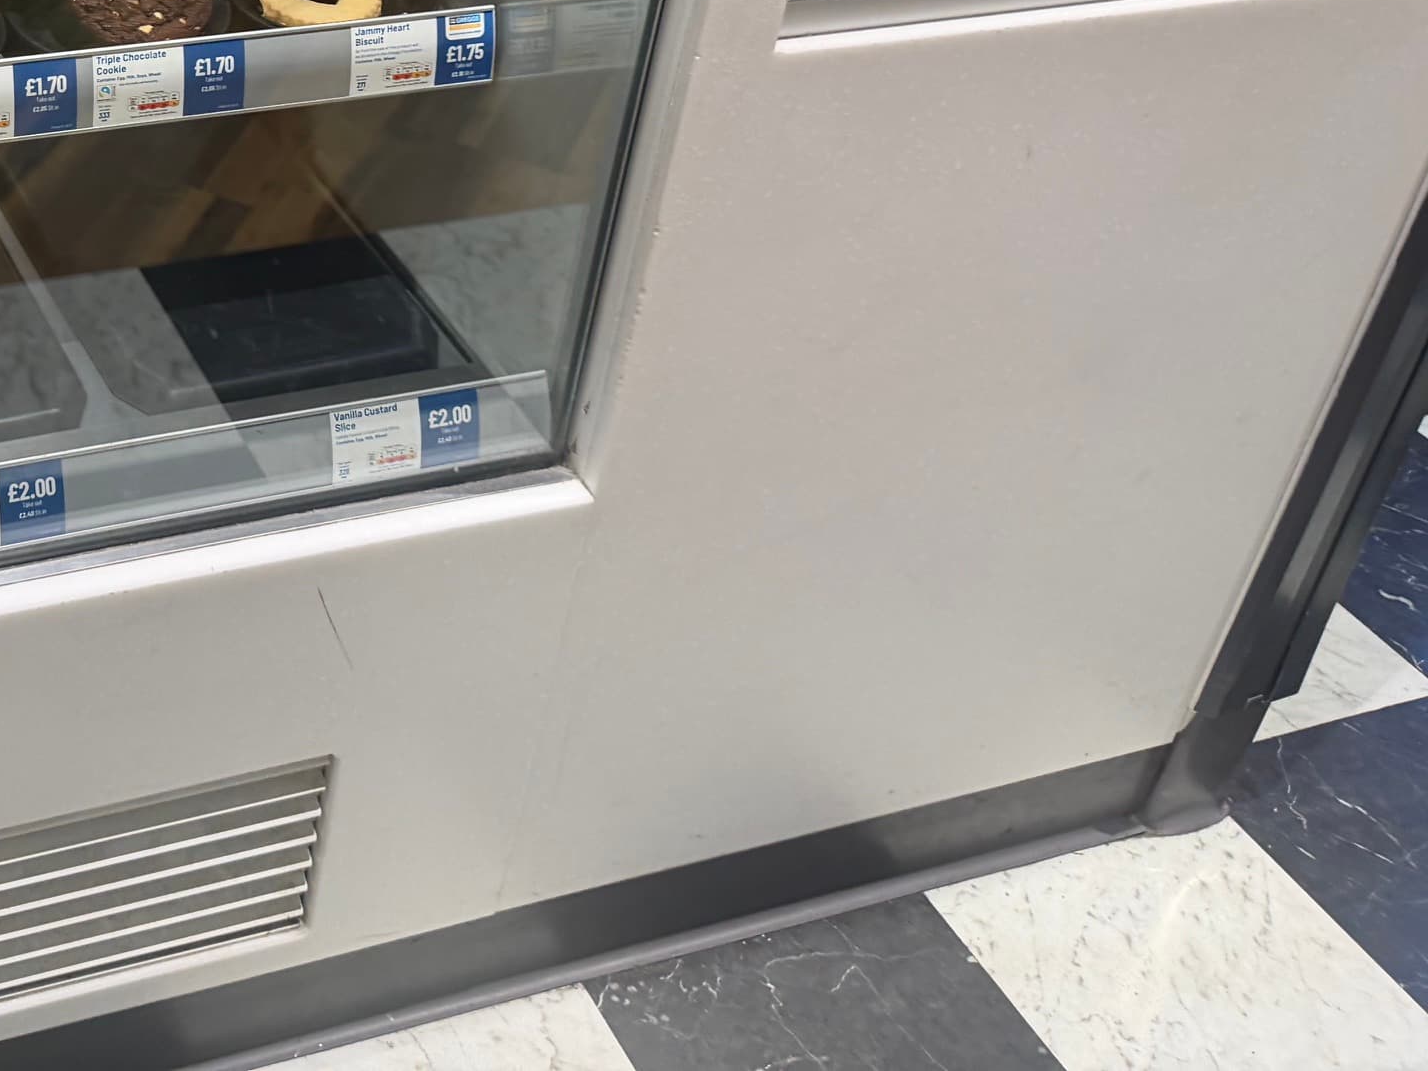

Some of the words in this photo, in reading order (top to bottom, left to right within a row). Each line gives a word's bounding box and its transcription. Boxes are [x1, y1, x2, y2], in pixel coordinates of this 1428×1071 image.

[355, 26, 385, 37] Jammy
[387, 23, 410, 33] Heart
[355, 36, 384, 46] Biscuit
[96, 56, 121, 65] Triple
[123, 51, 167, 62] Chocolate
[446, 43, 485, 63] £1.75
[96, 66, 127, 75] Cookie
[194, 55, 235, 77] £1.70
[25, 75, 67, 97] £1.70
[334, 409, 363, 422] Vanilla
[364, 403, 398, 417] Custard
[428, 404, 472, 429] £2.00
[335, 422, 356, 432] Slice
[8, 476, 57, 504] £2.00
